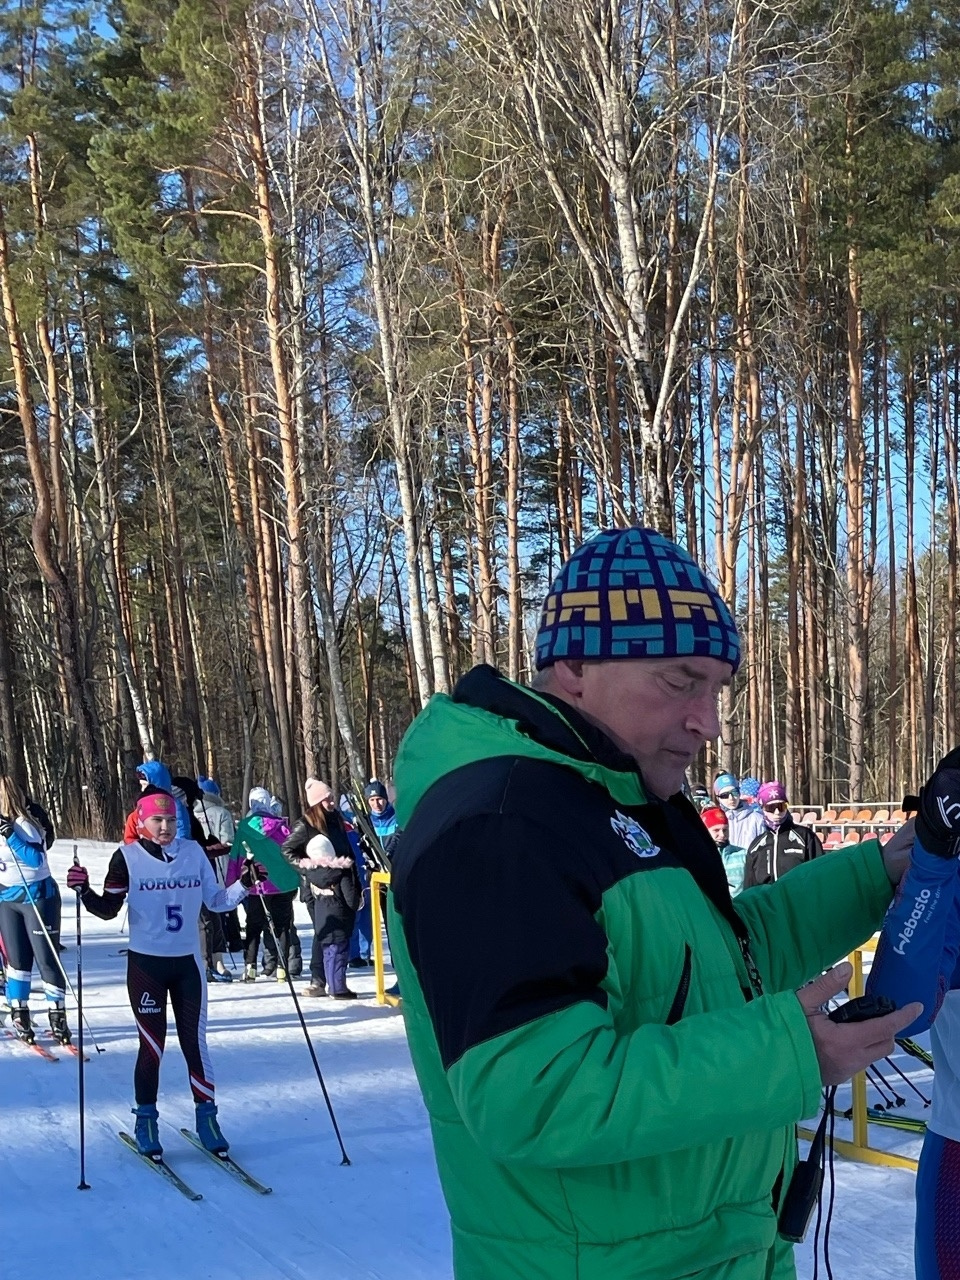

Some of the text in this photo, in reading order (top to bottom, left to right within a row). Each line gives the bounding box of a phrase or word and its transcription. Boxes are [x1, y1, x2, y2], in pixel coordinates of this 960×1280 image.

[139, 875, 201, 891] ЮНОСТЬ
[165, 904, 184, 933] 5
[893, 889, 931, 955] Webasto
